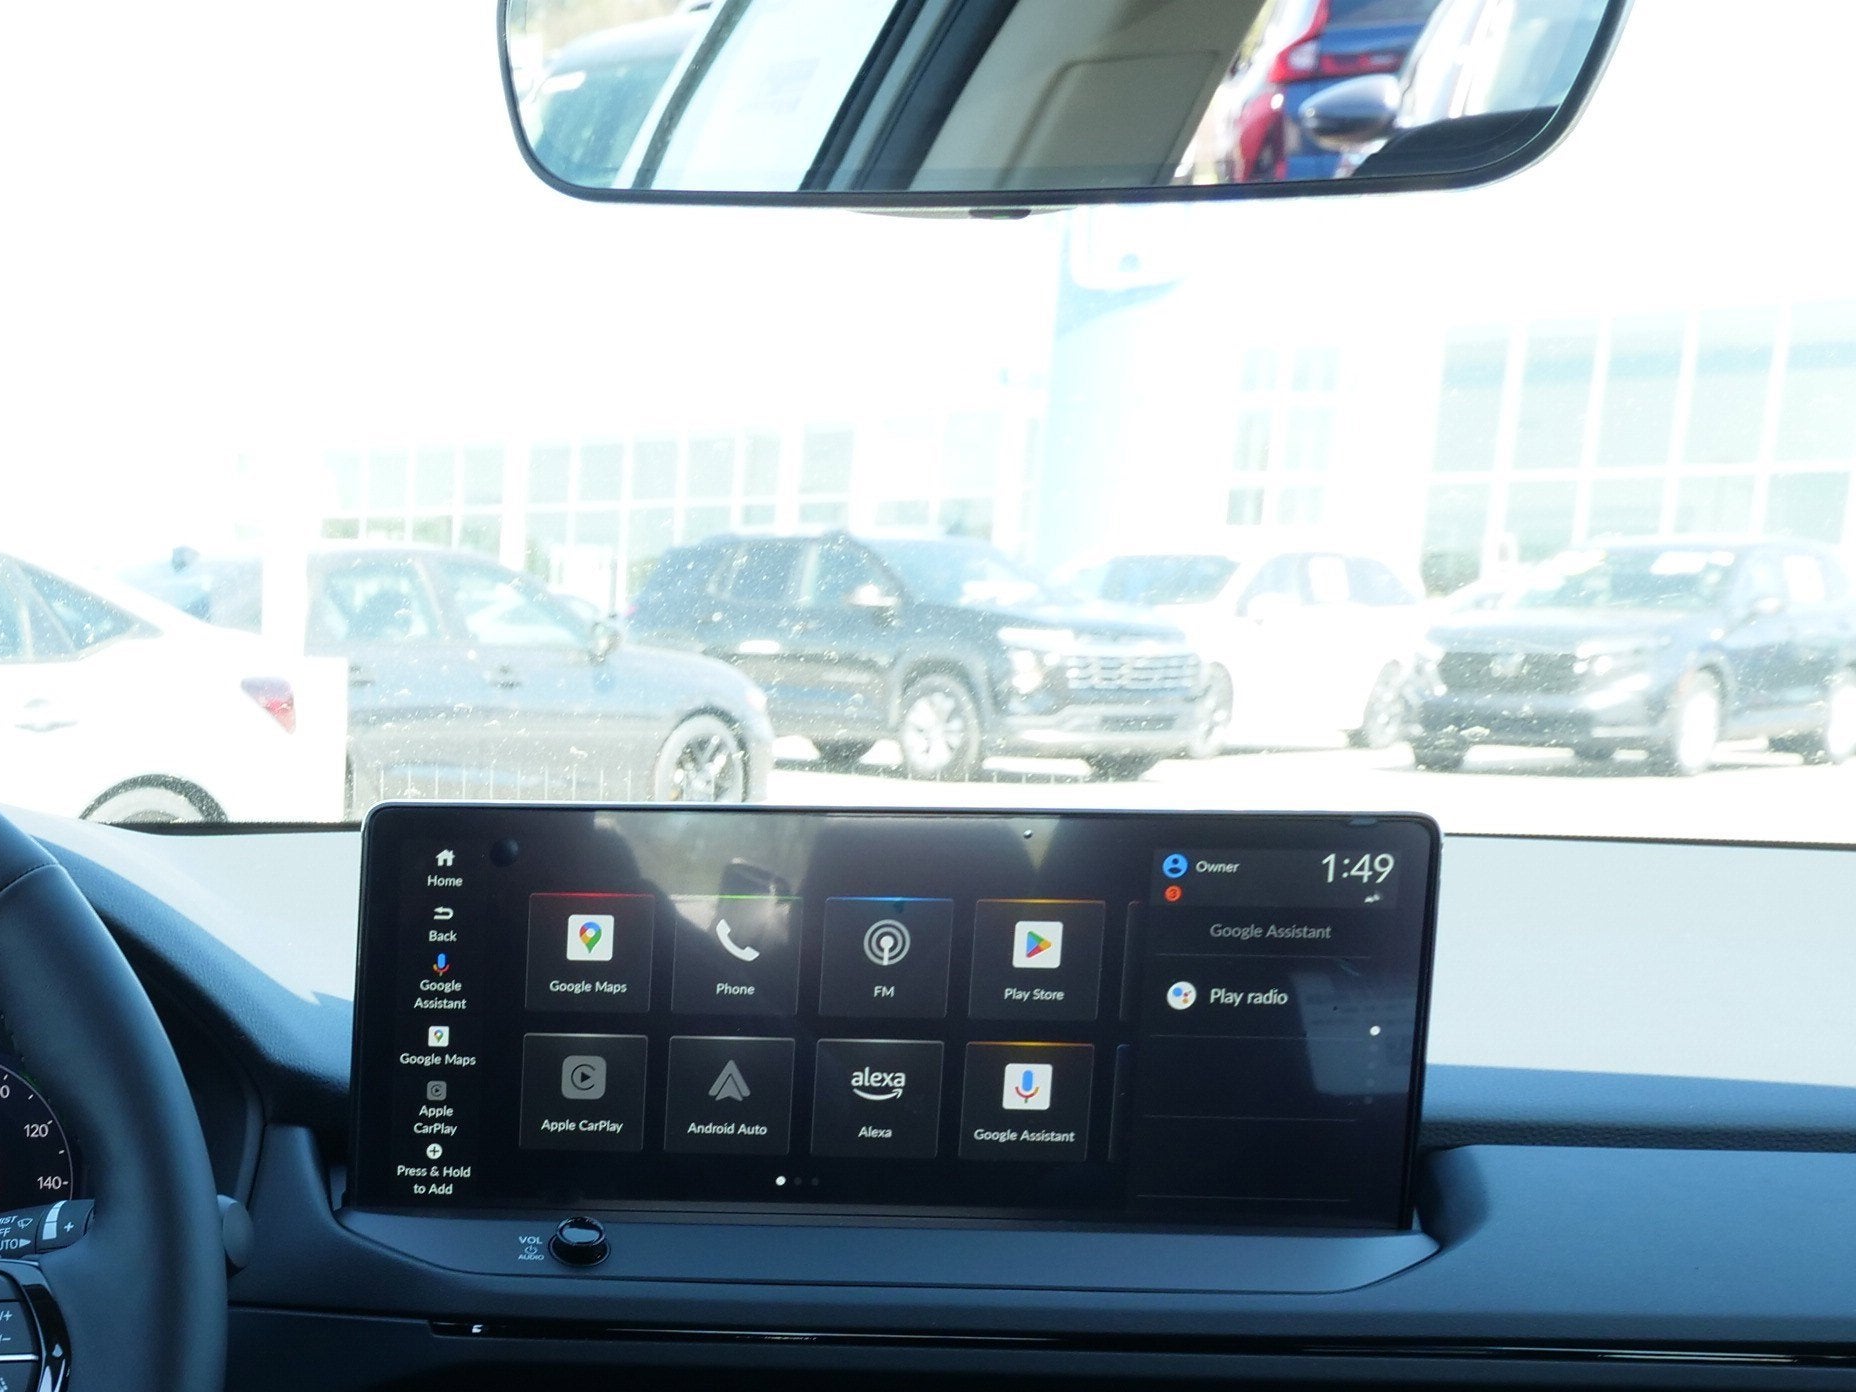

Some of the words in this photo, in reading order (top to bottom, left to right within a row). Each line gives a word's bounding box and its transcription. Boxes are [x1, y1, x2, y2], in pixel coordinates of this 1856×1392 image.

[1195, 860, 1240, 875] Owner
[1320, 853, 1395, 885] 1:49
[427, 875, 463, 888] Home
[428, 930, 458, 943] Back
[1209, 923, 1264, 940] Google
[1266, 924, 1332, 940] Assistant
[419, 980, 462, 994] Google
[549, 980, 595, 996] Google
[596, 981, 628, 996] Maps
[715, 982, 755, 997] Phone
[873, 985, 894, 998] FM
[1003, 988, 1030, 1003] Play
[1033, 988, 1065, 1001] Store
[1210, 988, 1244, 1007] Play
[1247, 989, 1288, 1006] radio
[413, 997, 467, 1010] Assistant
[399, 1053, 442, 1067] Google
[445, 1054, 476, 1067] Maps
[851, 1067, 906, 1089] alexa
[419, 1105, 454, 1119] Apple
[23, 1123, 49, 1138] 120
[413, 1122, 458, 1137] CarPlay
[540, 1119, 576, 1134] Apple
[578, 1119, 623, 1134] CarPlay
[687, 1122, 735, 1136] Android
[738, 1123, 768, 1136] Auto
[858, 1125, 893, 1139] Alexa
[973, 1128, 1018, 1144] Google
[1020, 1129, 1075, 1143] Assistant
[396, 1165, 428, 1178] Press
[430, 1166, 440, 1178] &
[442, 1165, 471, 1178] Hold
[37, 1176, 62, 1190] 140
[413, 1183, 424, 1195] to
[427, 1183, 453, 1195] Add
[518, 1236, 543, 1245] VOL
